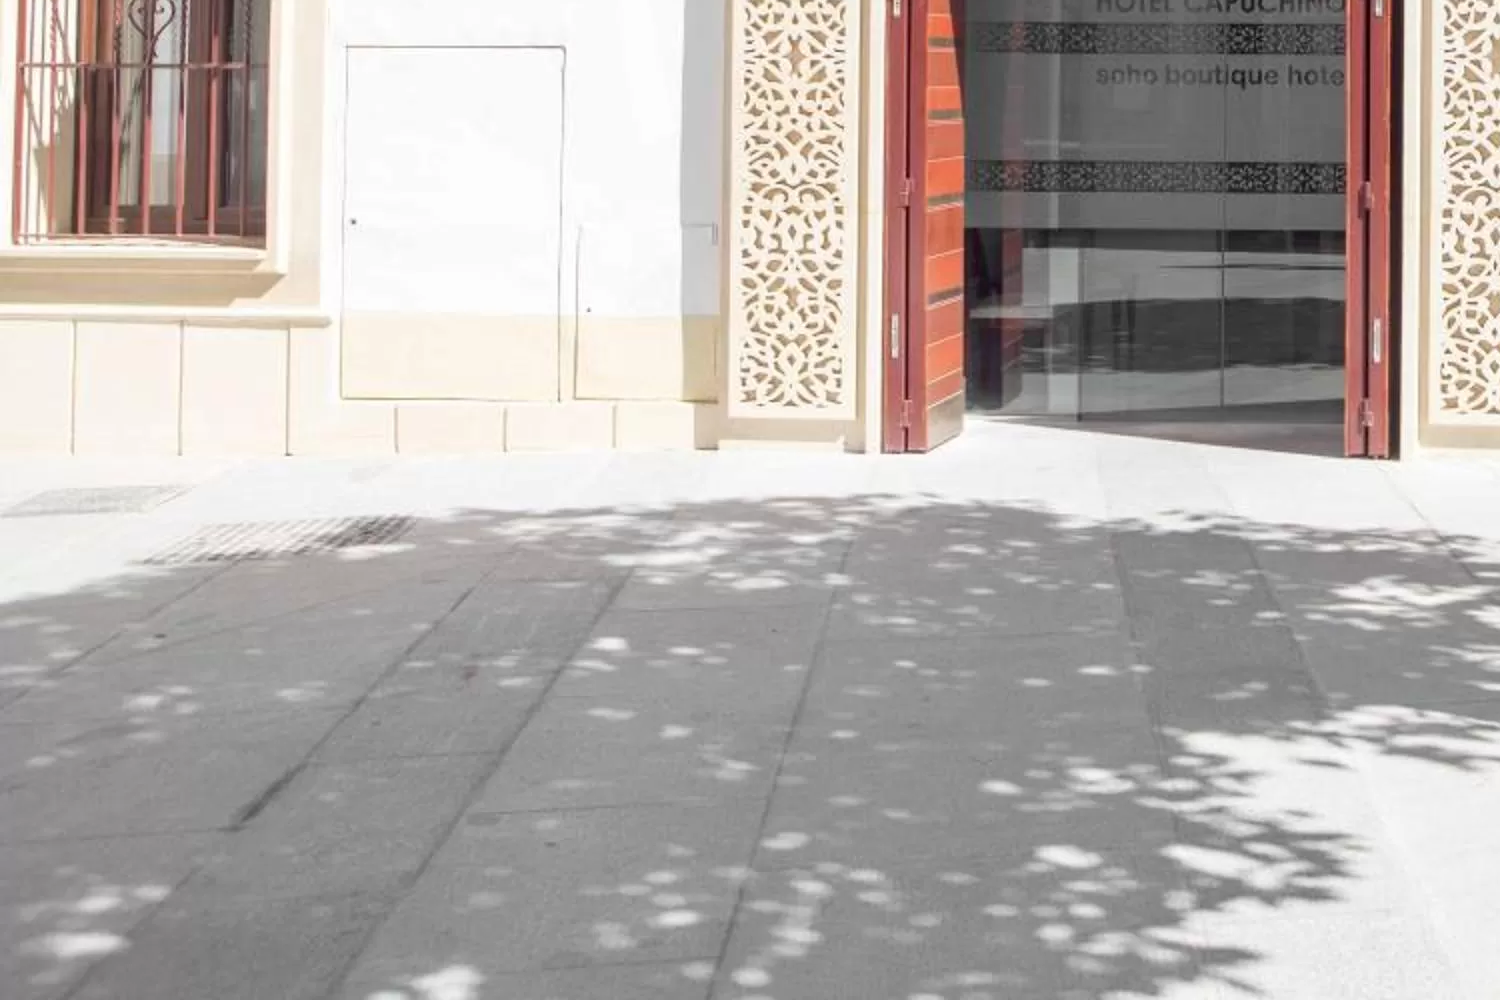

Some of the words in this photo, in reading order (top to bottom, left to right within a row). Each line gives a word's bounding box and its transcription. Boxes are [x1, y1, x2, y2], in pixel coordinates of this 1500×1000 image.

[1096, 64, 1158, 86] soho
[1165, 64, 1280, 91] boutique
[1287, 64, 1345, 86] hote
